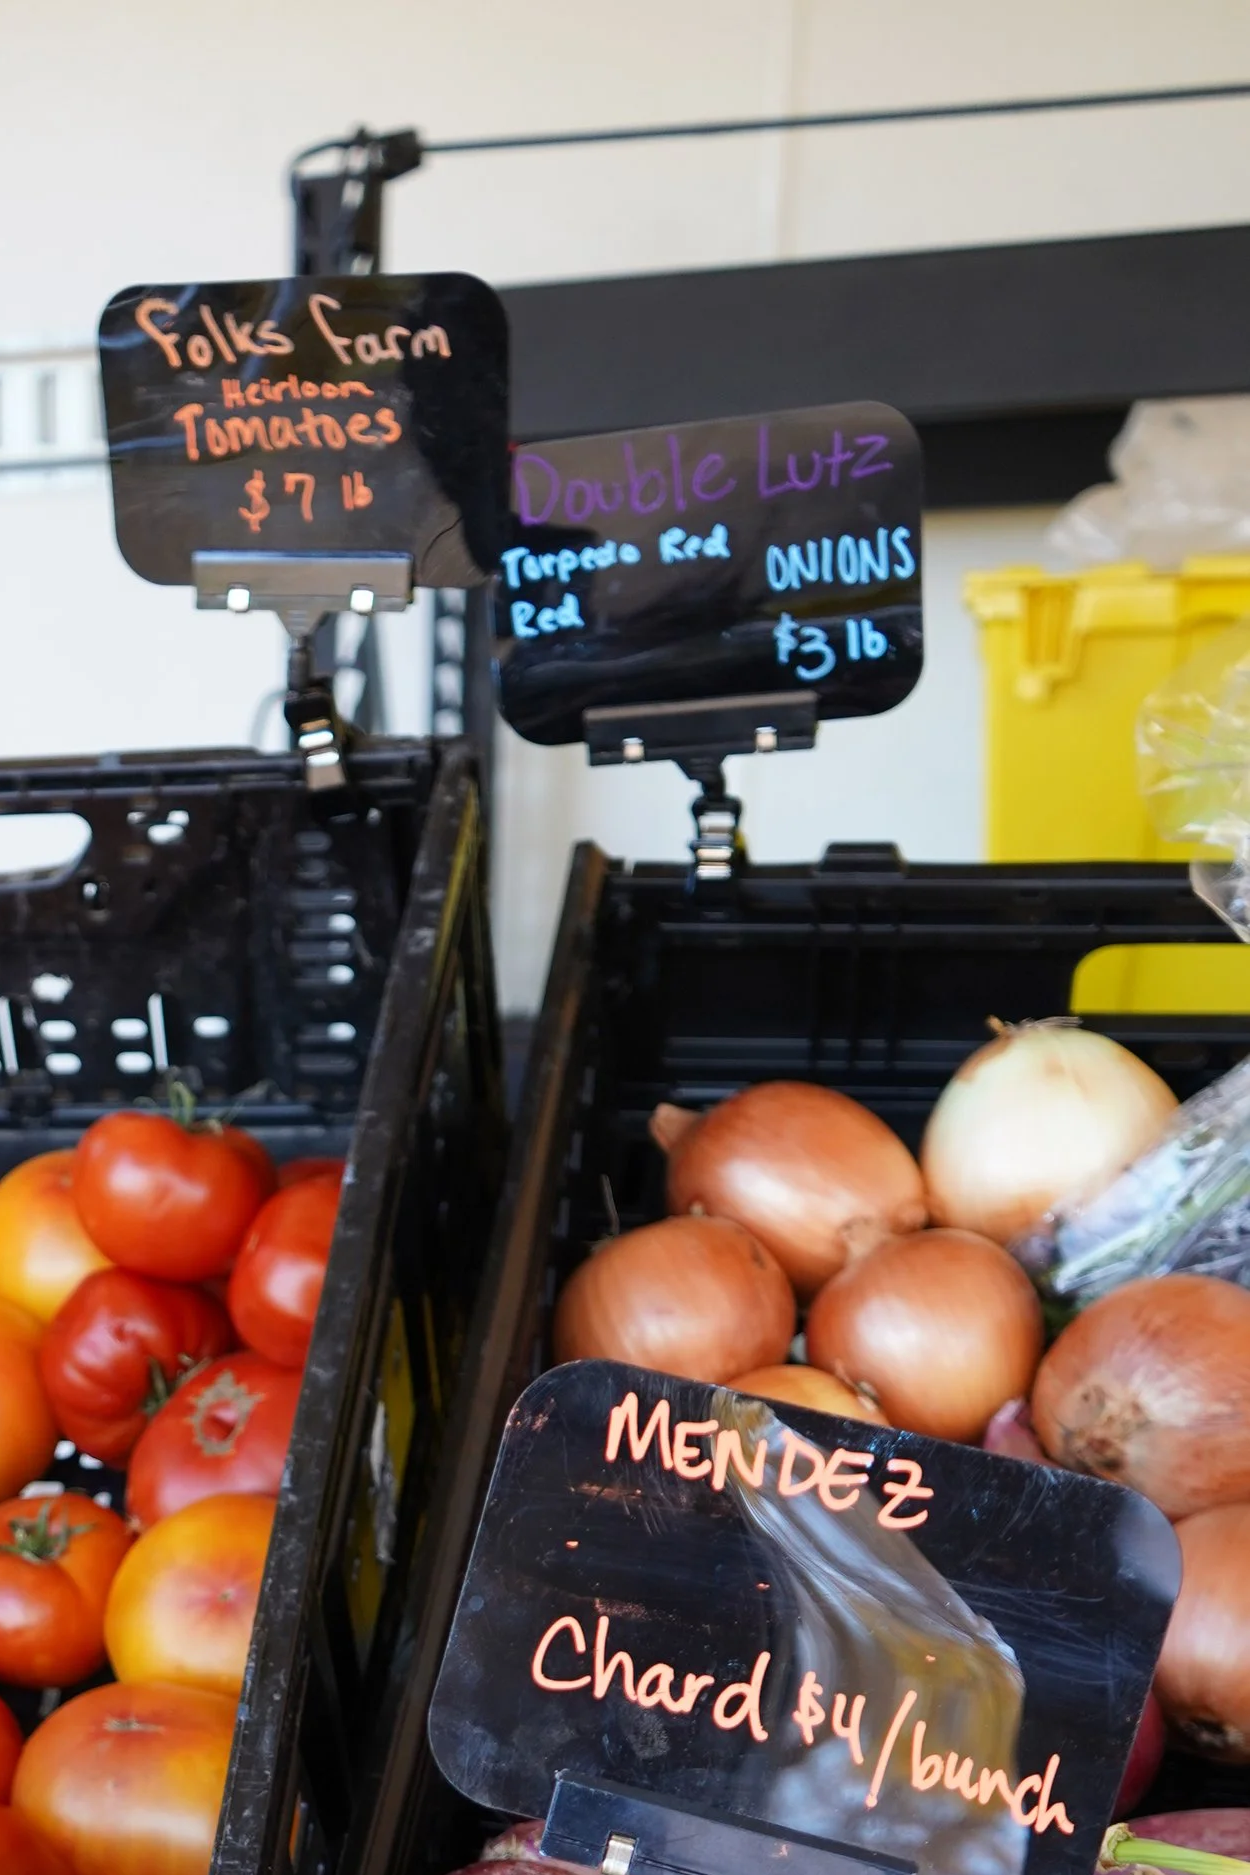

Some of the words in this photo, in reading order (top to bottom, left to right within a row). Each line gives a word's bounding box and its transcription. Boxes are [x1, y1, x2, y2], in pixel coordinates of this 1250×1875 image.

[221, 374, 375, 407] Heirloom
[173, 403, 402, 461] Tomatoes
[341, 471, 373, 510] lb
[515, 433, 738, 527] Double
[757, 423, 894, 497] Lutz
[501, 539, 641, 589] Torpedo
[659, 523, 731, 563] Red
[766, 526, 916, 591] ONIONS
[510, 593, 584, 640] Red
[773, 612, 836, 681] $3
[604, 1392, 934, 1530] MENDEZ
[531, 1616, 771, 1742] Chard
[793, 1672, 1074, 1835] $4/bunch
